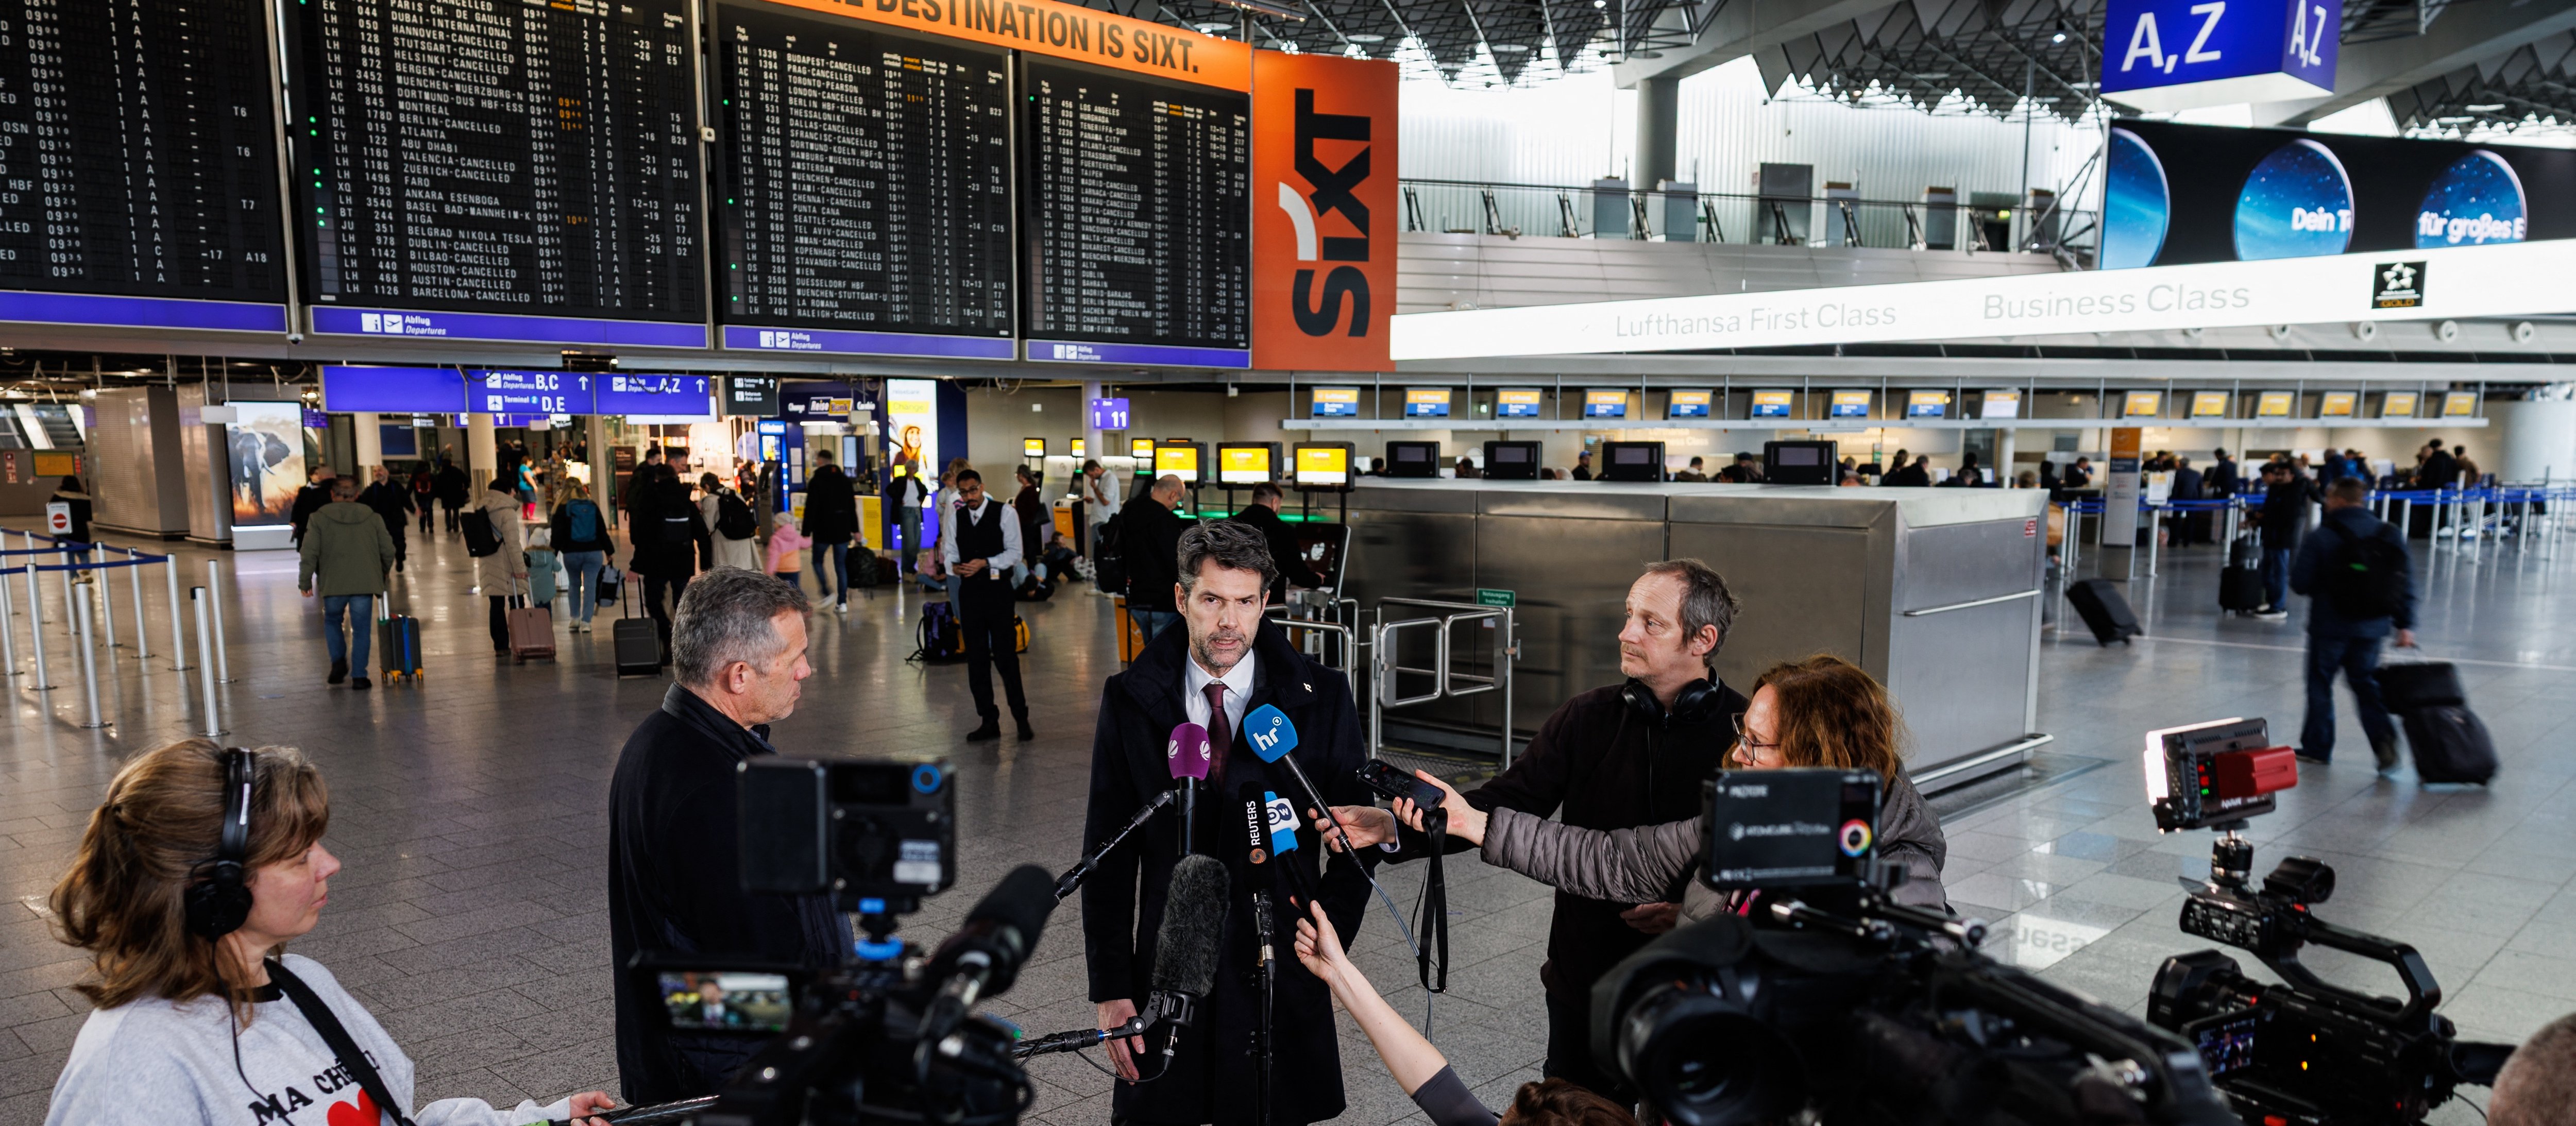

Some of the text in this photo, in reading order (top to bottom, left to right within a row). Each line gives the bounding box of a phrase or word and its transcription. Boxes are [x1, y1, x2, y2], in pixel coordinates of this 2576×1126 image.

[391, 11, 512, 39] DUBAI-INTERNATIONAL
[430, 5, 447, 15] CH.
[455, 9, 467, 20] DE
[474, 12, 511, 27] GAULLE
[392, 24, 507, 50] HANNOVER-CANCELLED
[2121, 1, 2226, 74] A,Z
[2289, 0, 2327, 67] A,Z
[1099, 22, 1123, 59] IS
[1134, 29, 1199, 74] SIXT.
[394, 49, 509, 75] HELSINKI-CANCELLED
[787, 53, 871, 75] BUDAPEST-CANCELLED
[395, 62, 497, 85] BERGEN-CANCELLED
[787, 64, 853, 82] PRAG-CANCELLED
[788, 75, 858, 93] TORONTO-PEARSON
[330, 92, 343, 102] AC
[365, 96, 384, 107] 845
[788, 86, 863, 105] LONDON-CANCELLED
[233, 106, 247, 117] T6
[481, 99, 523, 113] HBF-ESS
[788, 96, 817, 108] BERLIN
[822, 102, 867, 115] HBF-KASSEL
[789, 107, 844, 122] THESSALONIKI
[332, 117, 446, 139] DL 015 ATLANTA
[399, 113, 501, 134] BERLIN-CANCELLED
[789, 118, 864, 136] DALLAS-CANCELLED
[333, 130, 457, 152] EY 122 ABU DHABI
[790, 129, 877, 148] SFRANCISC-CANCELLED
[237, 146, 250, 157] T6
[402, 151, 515, 172] VALENCIA-CANCELLED
[337, 169, 430, 187] LH 1496 FARO
[403, 163, 510, 183] ZUERICH-CANCELLED
[9, 180, 33, 191] HBF
[338, 182, 499, 205] XQ 793 ANKARA ESENBOGA
[405, 200, 436, 212] BASEL
[792, 193, 871, 209] CHENNAI-CANCELLED
[793, 203, 840, 215] PUNTA CANA
[340, 207, 432, 224] BT 244 RIGA
[793, 214, 871, 229] SEATTLE-CANCELLED
[1292, 89, 1371, 337] SIXT
[341, 220, 532, 244] JU 351 BELGRAD NIKOLA TESLA
[794, 225, 876, 240] TEL AVIV-CANCELLED
[2292, 207, 2335, 231] Dein
[2419, 211, 2447, 236] für
[2447, 212, 2512, 244] großes
[342, 233, 509, 254] LH 978 DUBLIN-CANCELLED
[246, 252, 267, 263] A18
[343, 246, 509, 266] LH 1142 BILBAO-CANCELLED
[794, 246, 881, 261] KOPENHAGE-CANCELLED
[411, 263, 516, 278] HOUSTON-CANCELLED
[795, 257, 882, 271] STAVANGER-CANCELLED
[412, 275, 511, 289] AUSTIN-CANCELLED
[796, 277, 864, 289] DUESSELDORF HBF
[346, 283, 530, 302] LH 1126 BARCELONA-CANCELLED
[1617, 284, 2250, 337] Lufthansa First Class Business Class
[2380, 299, 2415, 307] GOLD
[405, 315, 430, 326] Abflug
[797, 309, 874, 320] RALEIGH-CANCELLED
[405, 326, 446, 335] Departures
[791, 332, 810, 342] Abflug
[791, 341, 821, 349] Departures
[502, 373, 558, 391] Abflug B,C
[503, 381, 534, 390] Departures
[659, 378, 681, 394] A,Z
[541, 396, 565, 413] D,E
[810, 400, 849, 412] Reise Bank
[1111, 412, 1127, 428] 11
[1253, 727, 1279, 751] hr
[1247, 800, 1260, 846] REUTERS
[248, 1086, 313, 1126] MA
